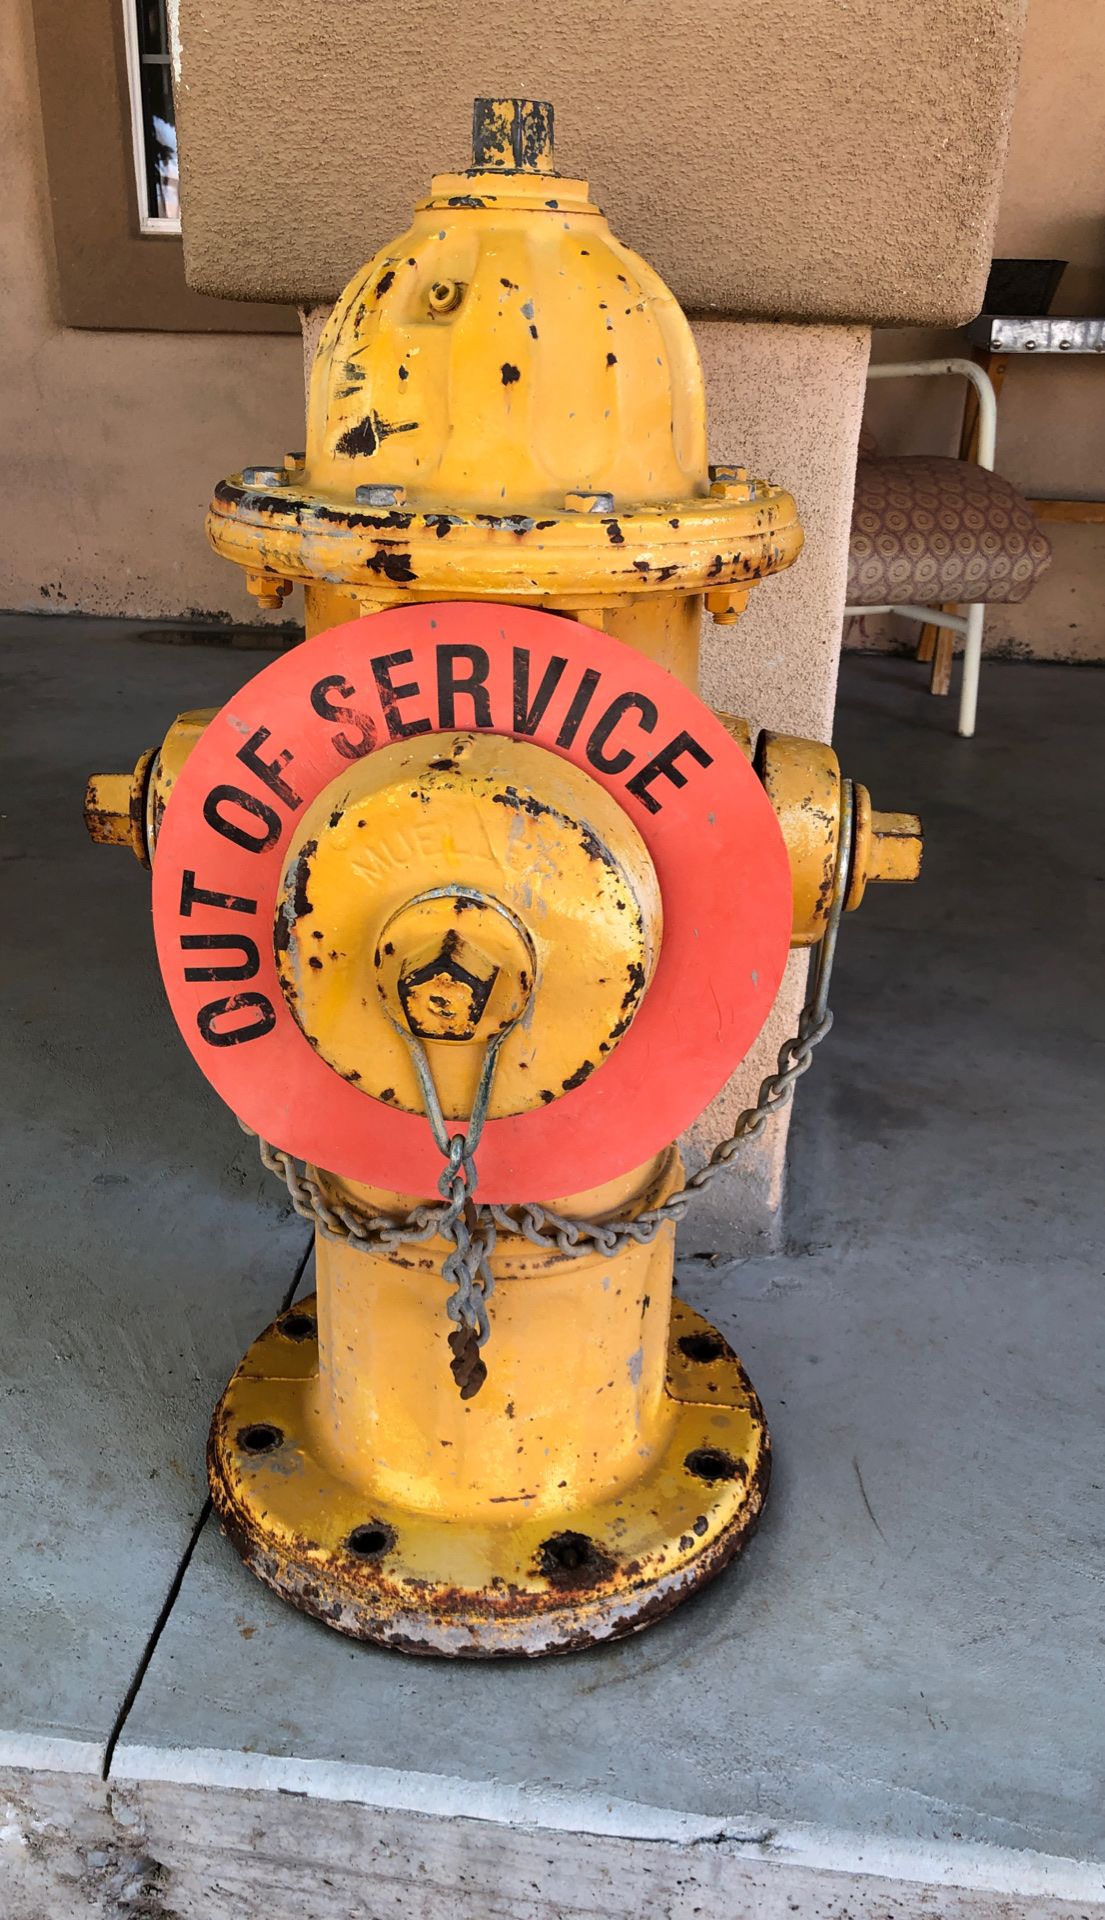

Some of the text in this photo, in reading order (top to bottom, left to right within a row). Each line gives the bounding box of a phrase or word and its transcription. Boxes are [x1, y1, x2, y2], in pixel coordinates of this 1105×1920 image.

[179, 643, 715, 1049] OUT OF SERVICE
